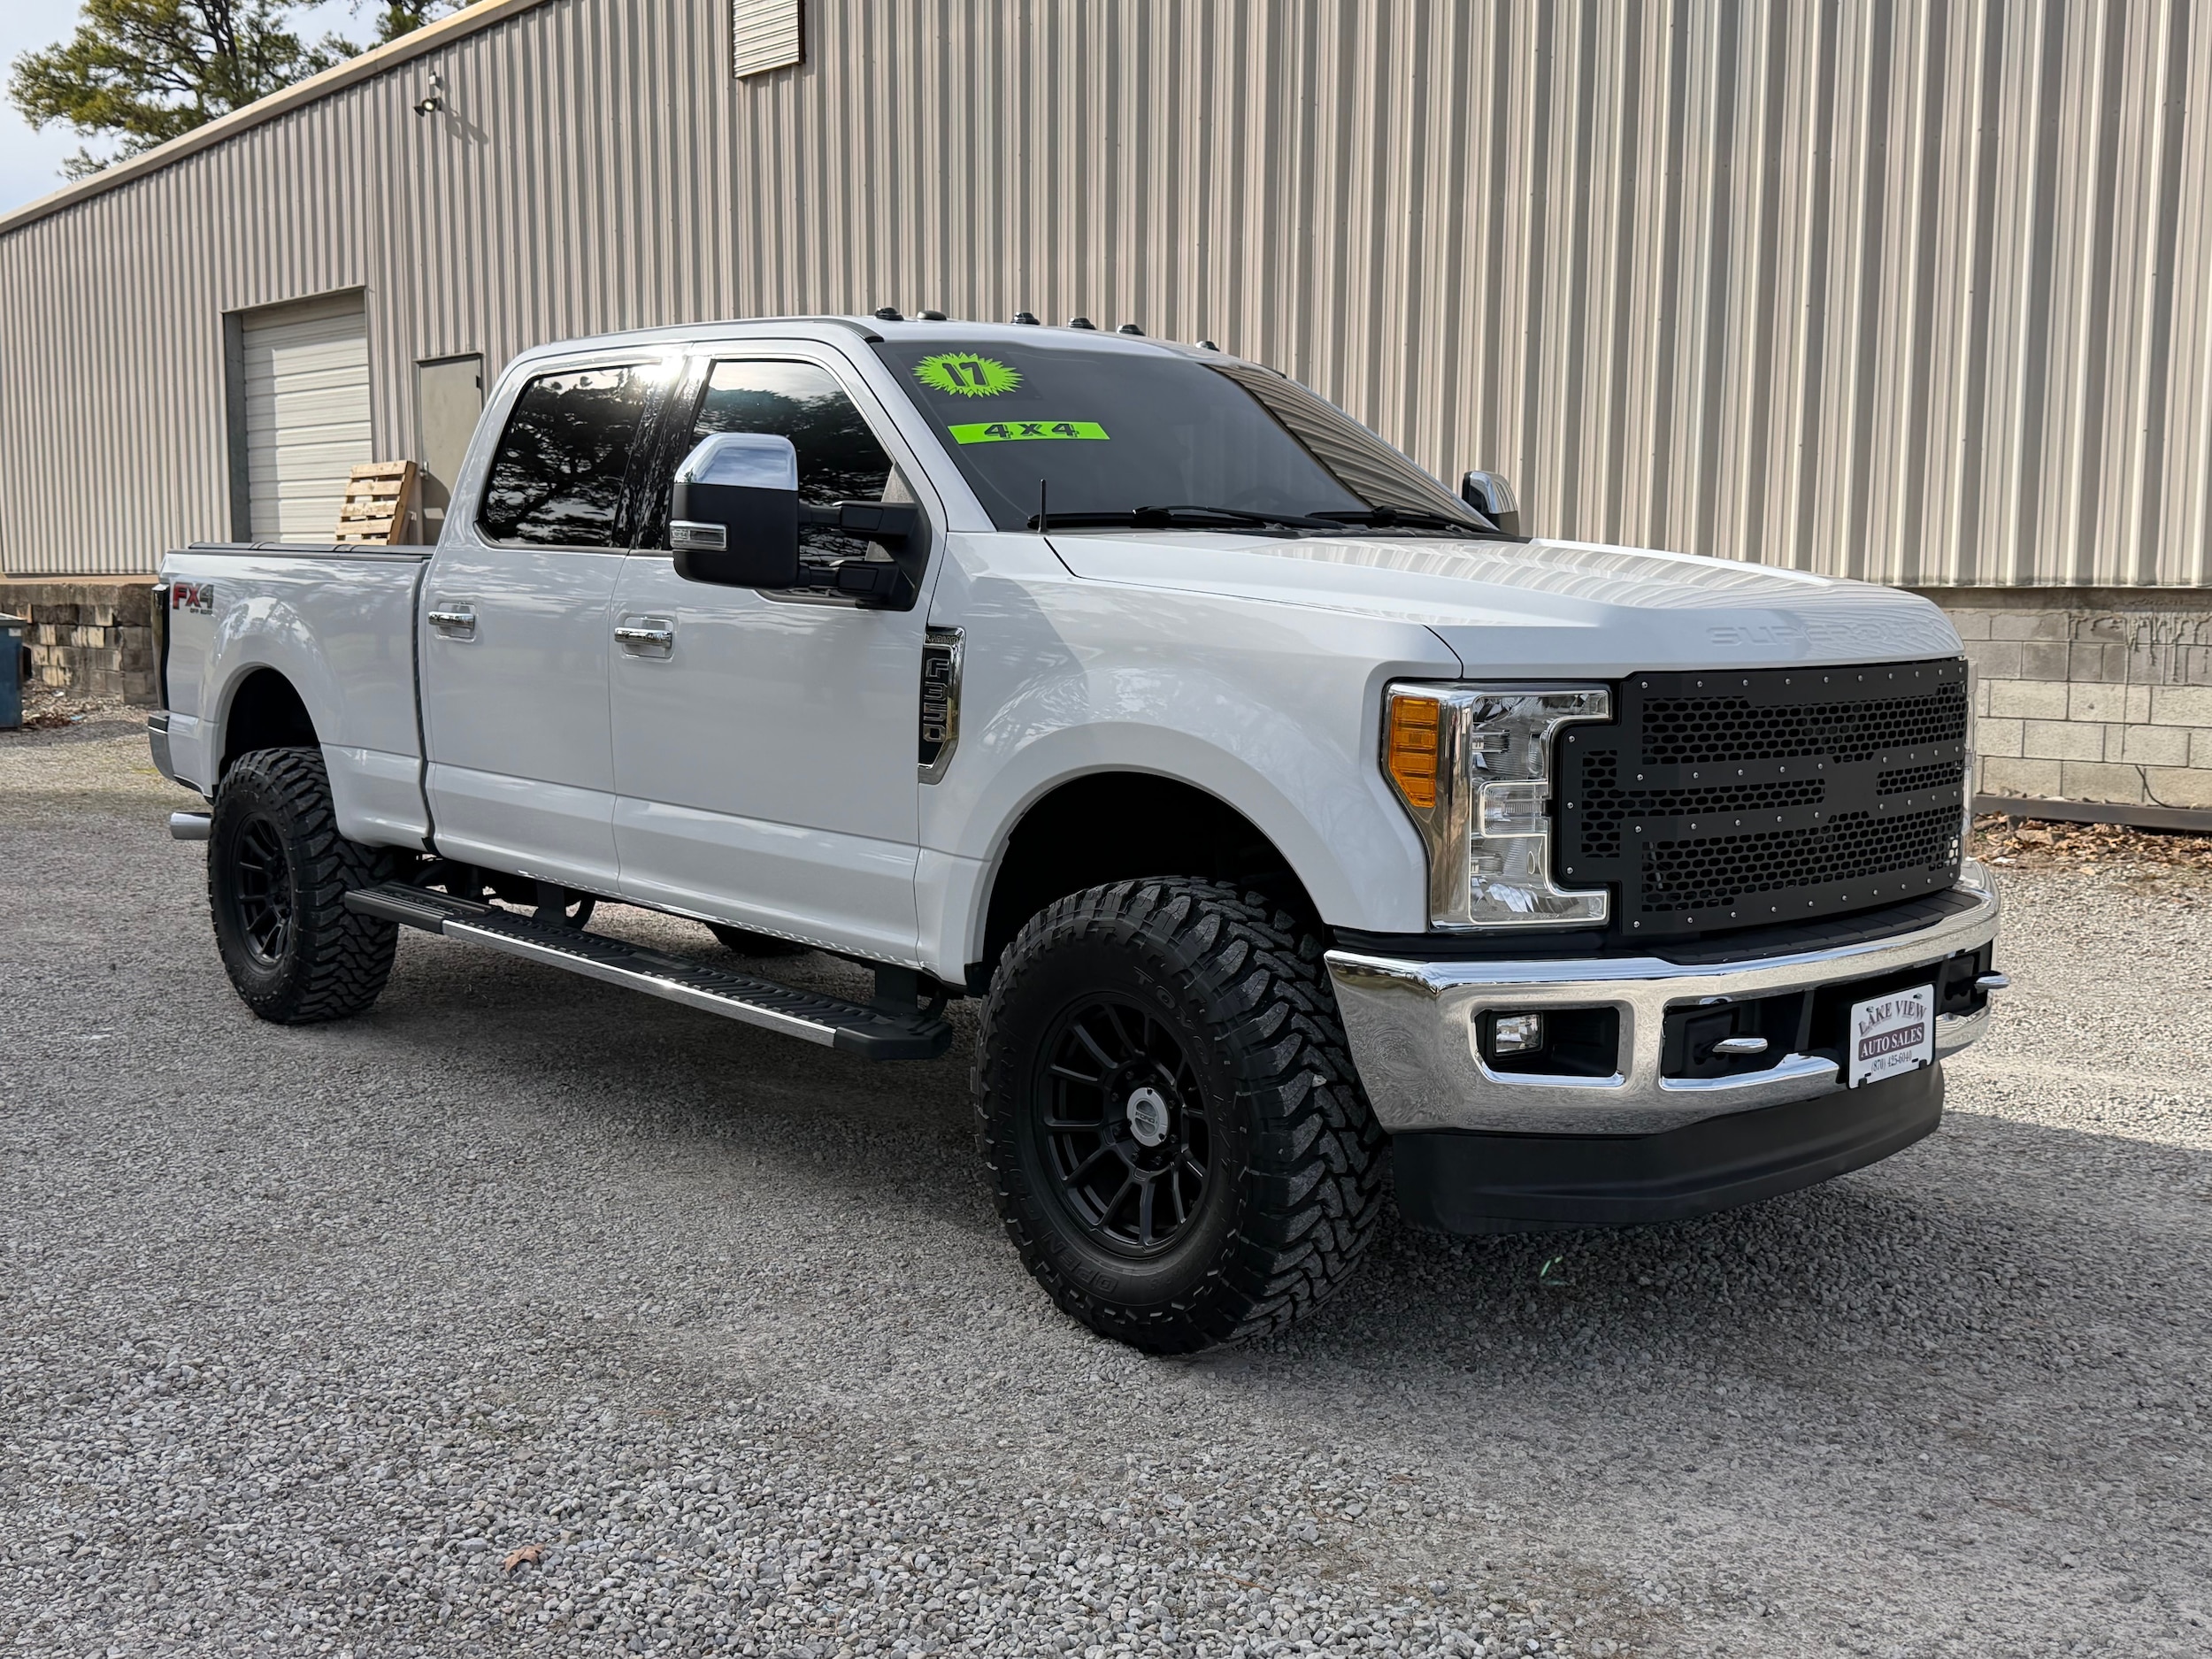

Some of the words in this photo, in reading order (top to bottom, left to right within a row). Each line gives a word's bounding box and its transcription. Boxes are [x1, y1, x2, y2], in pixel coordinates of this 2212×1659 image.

[941, 361, 989, 388] 17
[173, 582, 214, 611] FX4
[1133, 964, 1210, 1066] TOYO
[1858, 1002, 1893, 1037] LAKE
[1895, 1000, 1927, 1021] VIEW
[1861, 1036, 1890, 1057] AUTO
[1891, 1026, 1923, 1048] SALES
[1871, 1057, 1886, 1073] (870)
